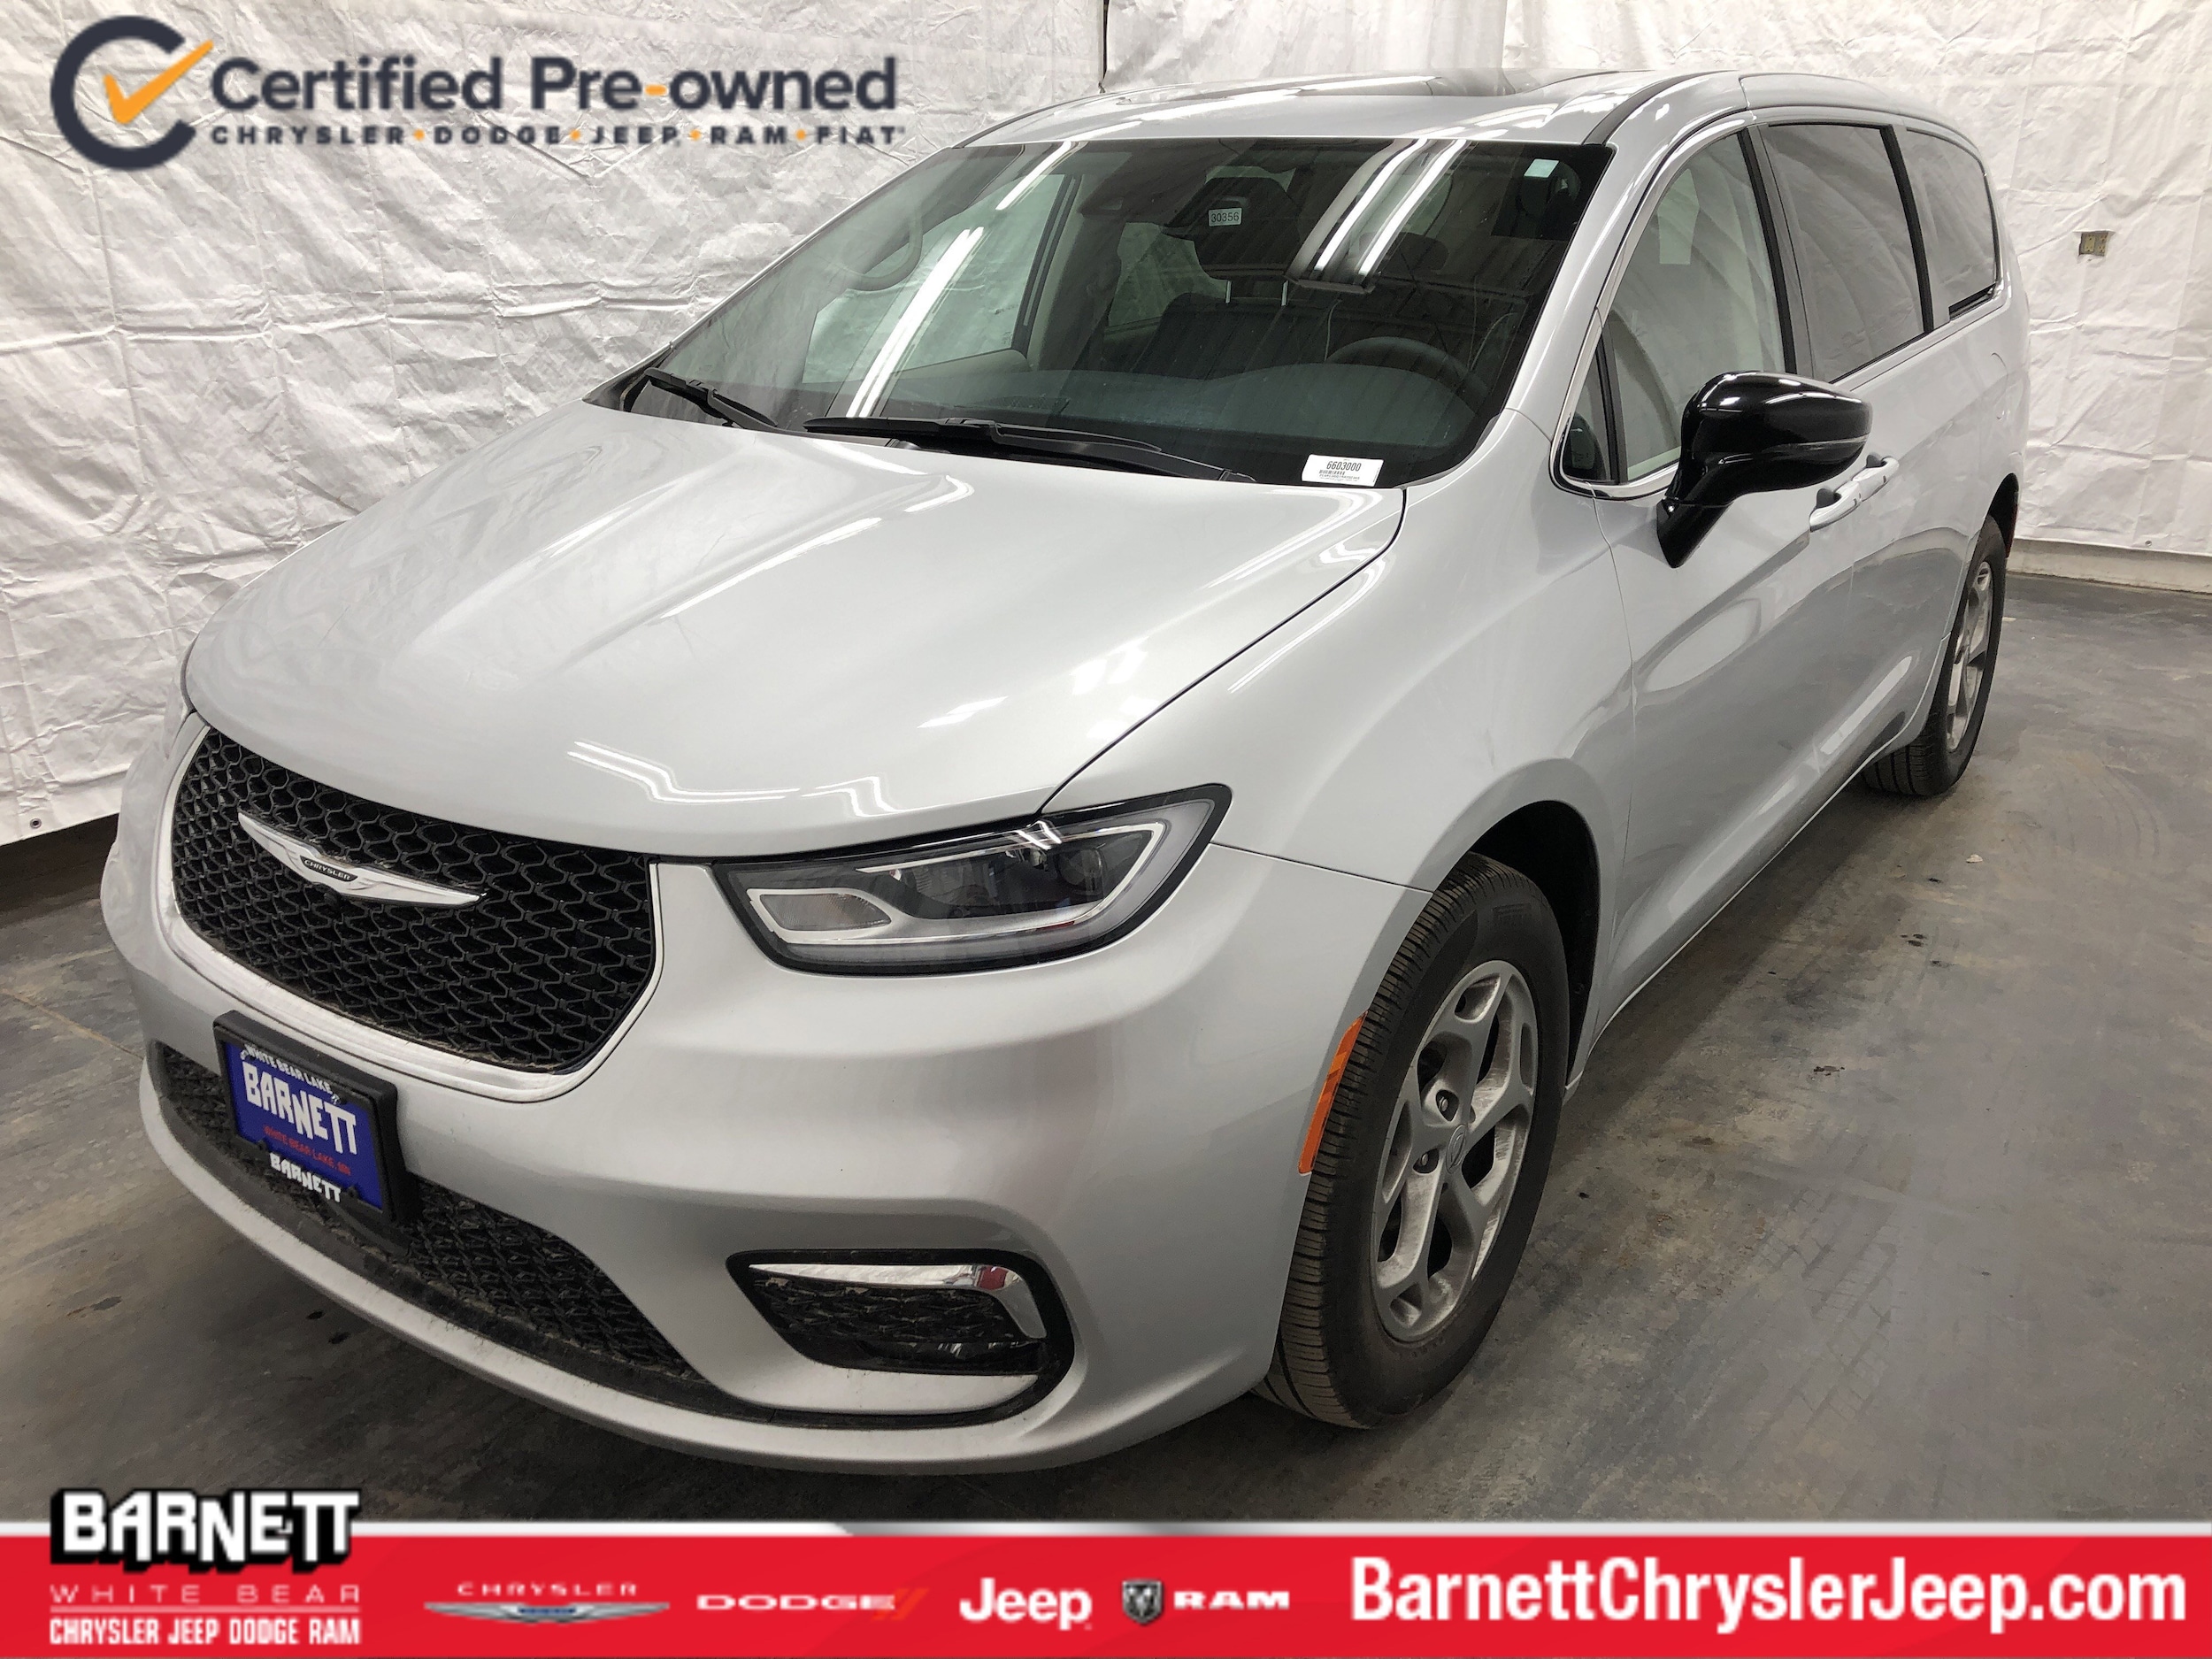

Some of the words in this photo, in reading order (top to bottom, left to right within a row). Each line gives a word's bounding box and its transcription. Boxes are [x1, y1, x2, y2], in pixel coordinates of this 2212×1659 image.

[1211, 212, 1240, 222] 30356
[1326, 461, 1362, 472] 6603000
[304, 859, 351, 880] CHRYSLER
[275, 1058, 305, 1081] BEAR
[303, 1071, 334, 1095] LAKE
[242, 1062, 357, 1155] BARNETT
[269, 1152, 342, 1203] BARNETT
